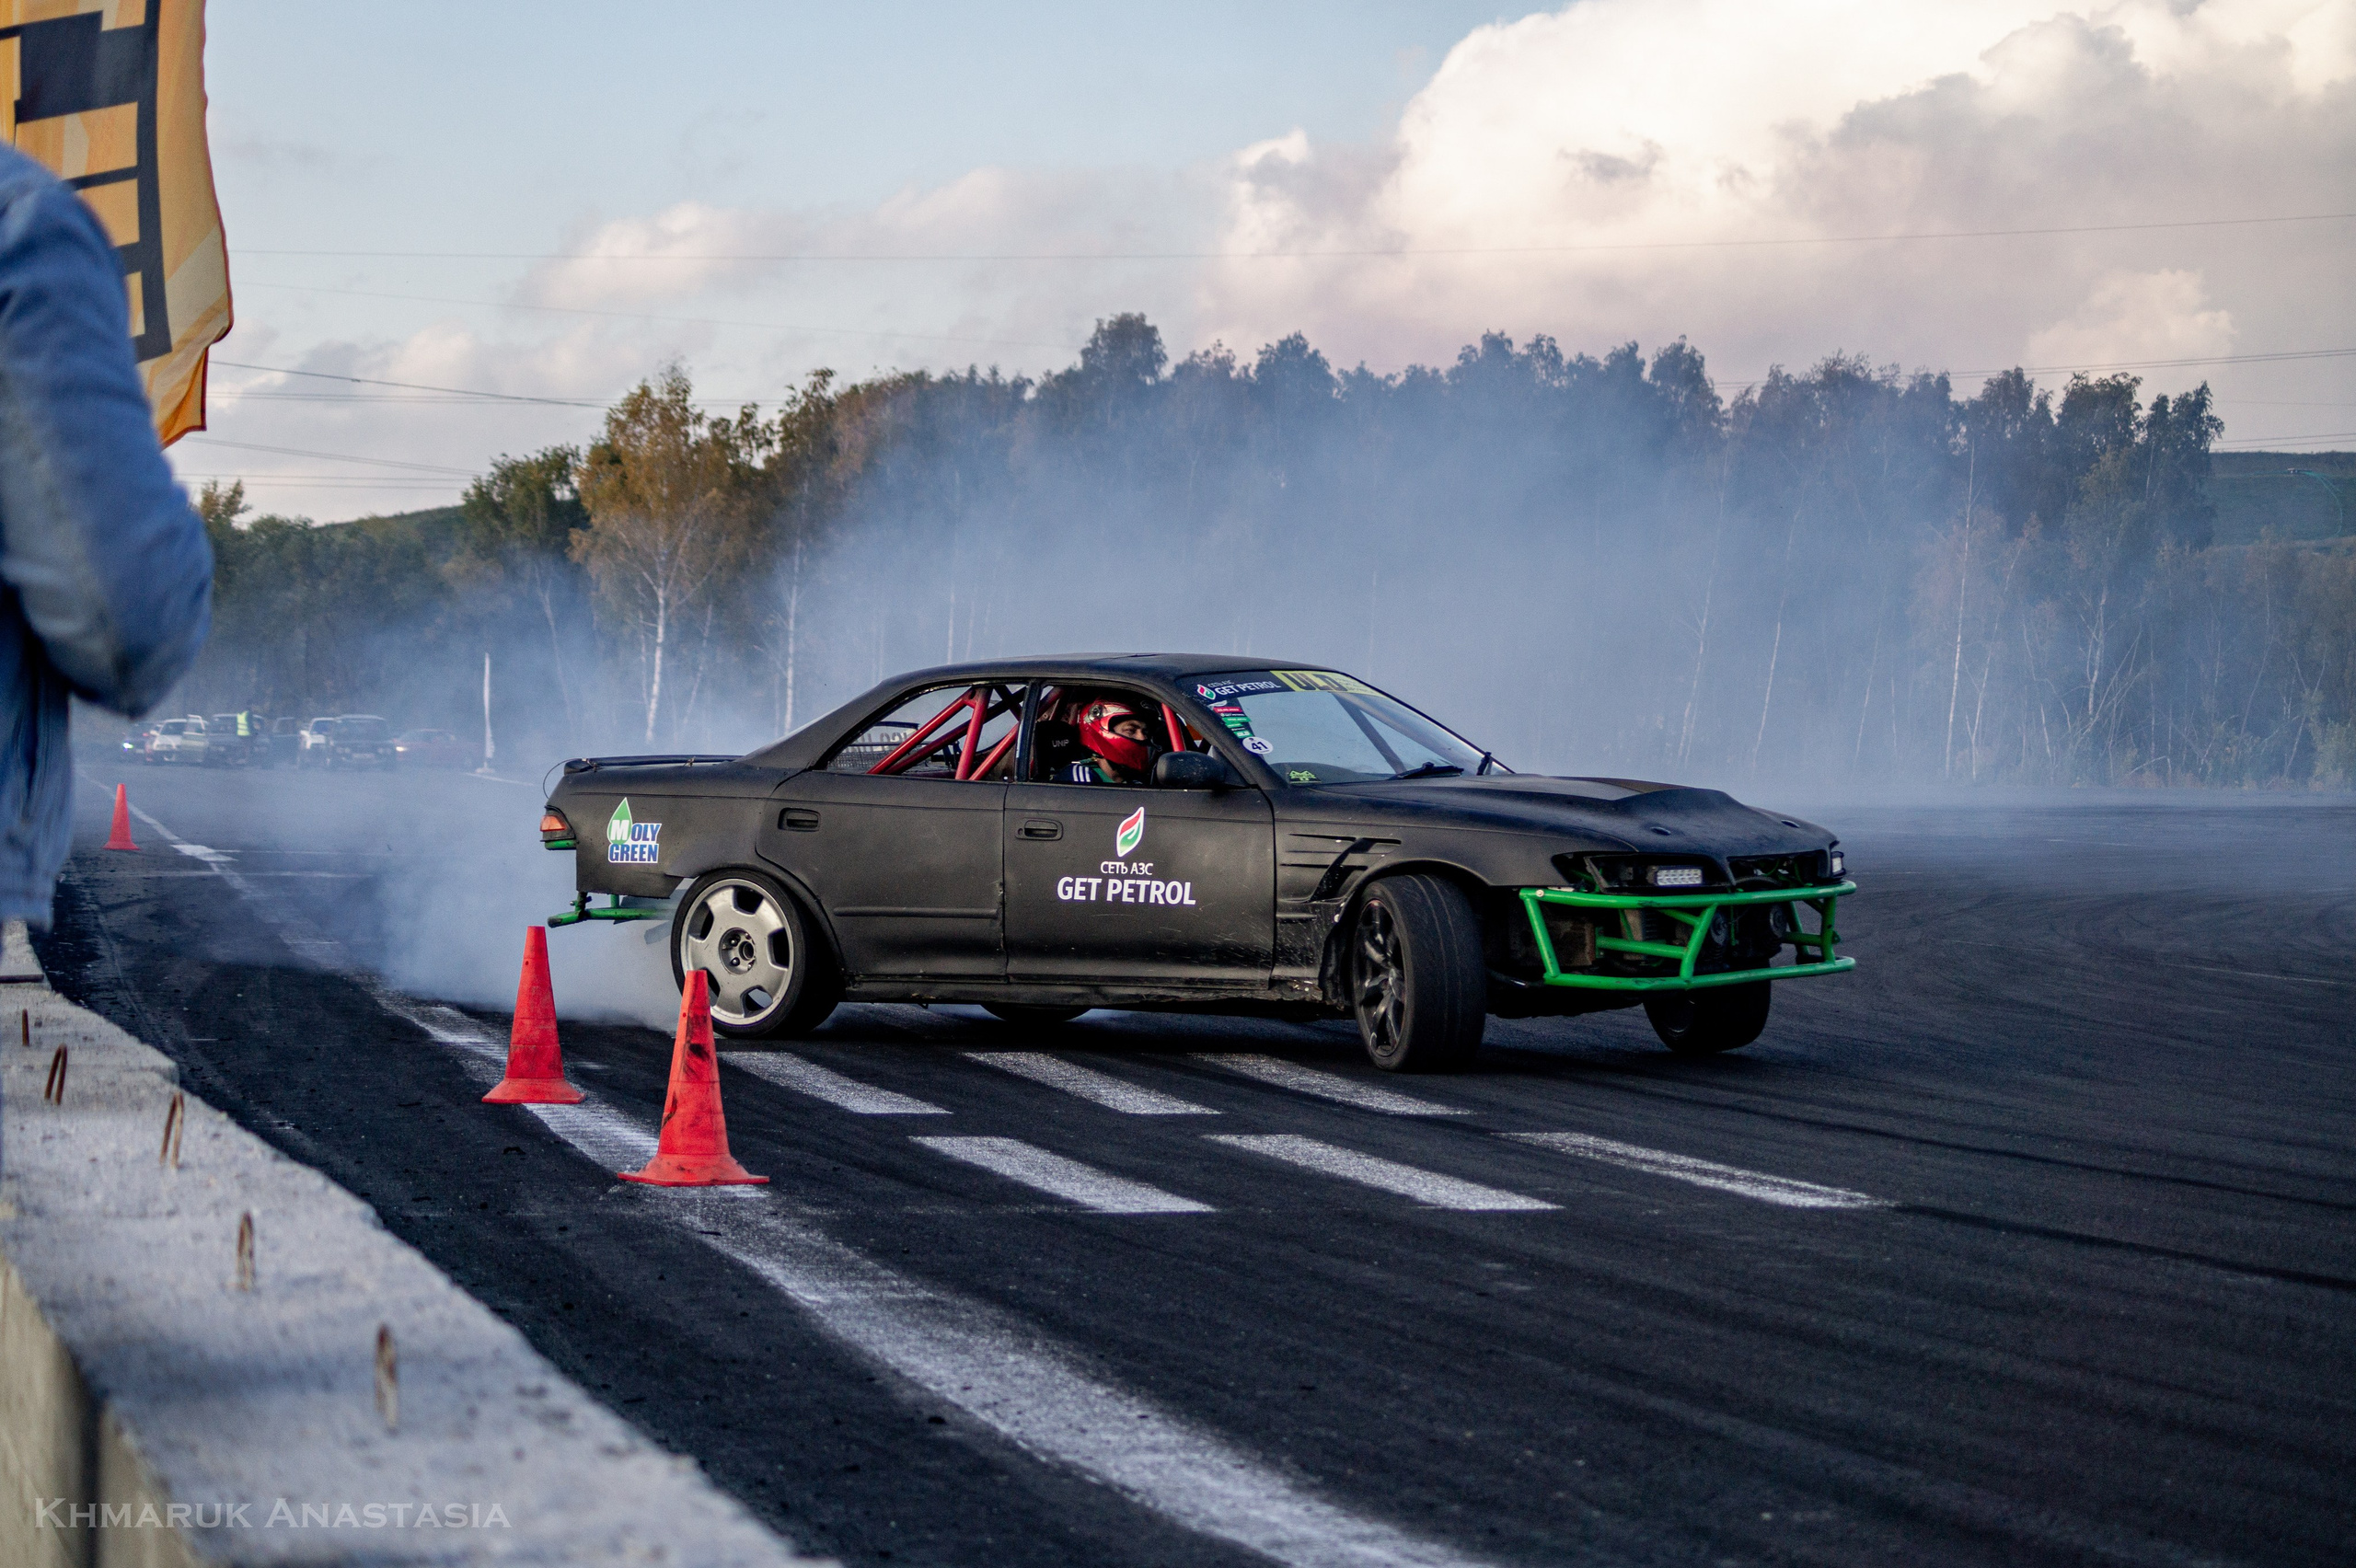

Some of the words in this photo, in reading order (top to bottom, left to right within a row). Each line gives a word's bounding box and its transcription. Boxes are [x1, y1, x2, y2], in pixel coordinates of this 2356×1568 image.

[1215, 685, 1239, 696] GET
[1236, 681, 1282, 692] PETROL
[1252, 741, 1268, 751] 41
[610, 819, 661, 842] MOLY
[608, 843, 658, 862] GREEN
[1100, 861, 1128, 874] СЕТЬ
[1130, 862, 1153, 875] АЗС
[1057, 876, 1103, 901] GET
[1106, 878, 1196, 905] PETROL
